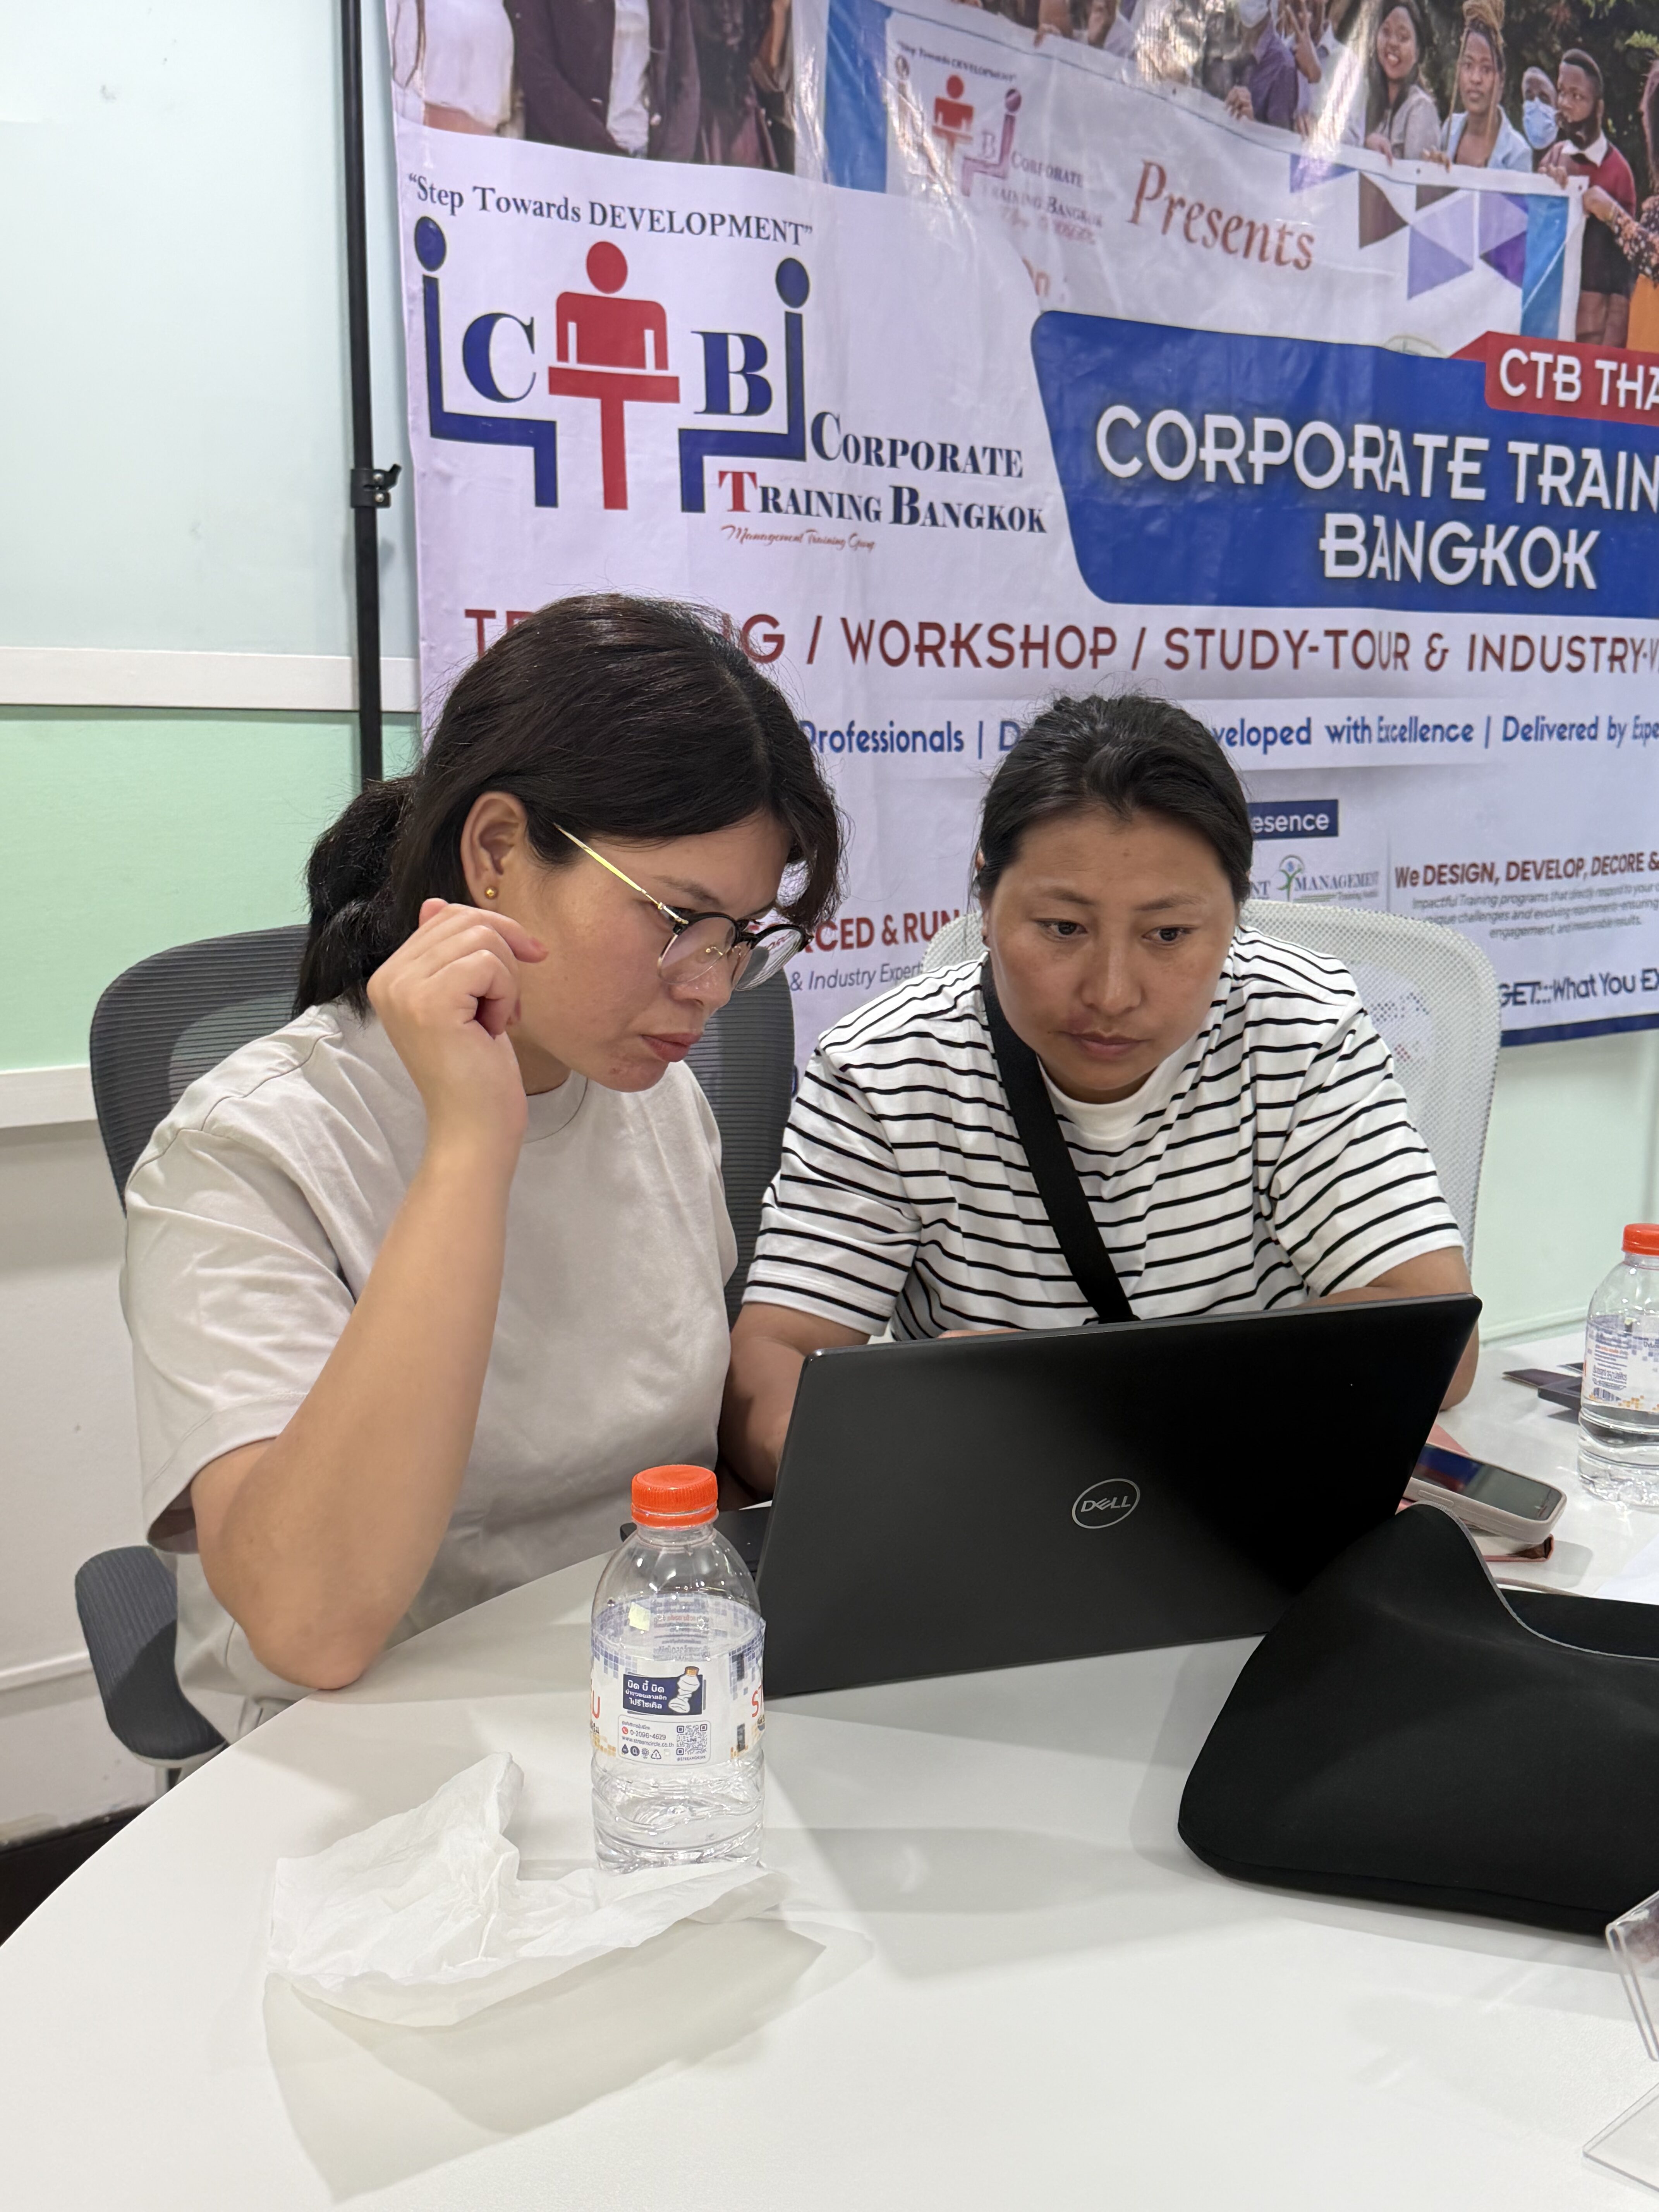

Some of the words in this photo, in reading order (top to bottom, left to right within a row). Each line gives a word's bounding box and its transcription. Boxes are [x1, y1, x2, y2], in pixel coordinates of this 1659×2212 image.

[473, 185, 581, 222] Towards
[589, 201, 814, 246] DEVELOPMENT”
[1126, 158, 1314, 271] Presents
[1499, 348, 1582, 402] CTB
[810, 411, 1024, 479] CORPORATE
[1096, 404, 1491, 501] CORPORATE
[1508, 441, 1659, 514] TRAIN
[718, 470, 882, 523] TRAINING
[889, 485, 1048, 534] BANGKOK
[1319, 512, 1601, 590] BANGKOK
[840, 617, 1117, 670] WORKSHOP
[1164, 627, 1410, 672] STUDY-TOUR
[1424, 632, 1450, 672] &
[1324, 716, 1372, 745] with
[1377, 715, 1475, 744] Excellence
[1501, 715, 1599, 742] Delivered
[1607, 715, 1628, 749] by
[1395, 866, 1419, 889] We
[1423, 861, 1500, 886] DESIGN,
[1505, 857, 1588, 883] DEVELOP,
[1590, 852, 1644, 877] DECORE
[881, 914, 899, 946] &
[790, 971, 804, 991] &
[808, 967, 876, 990] Industry
[1080, 1496, 1131, 1513] DELL
